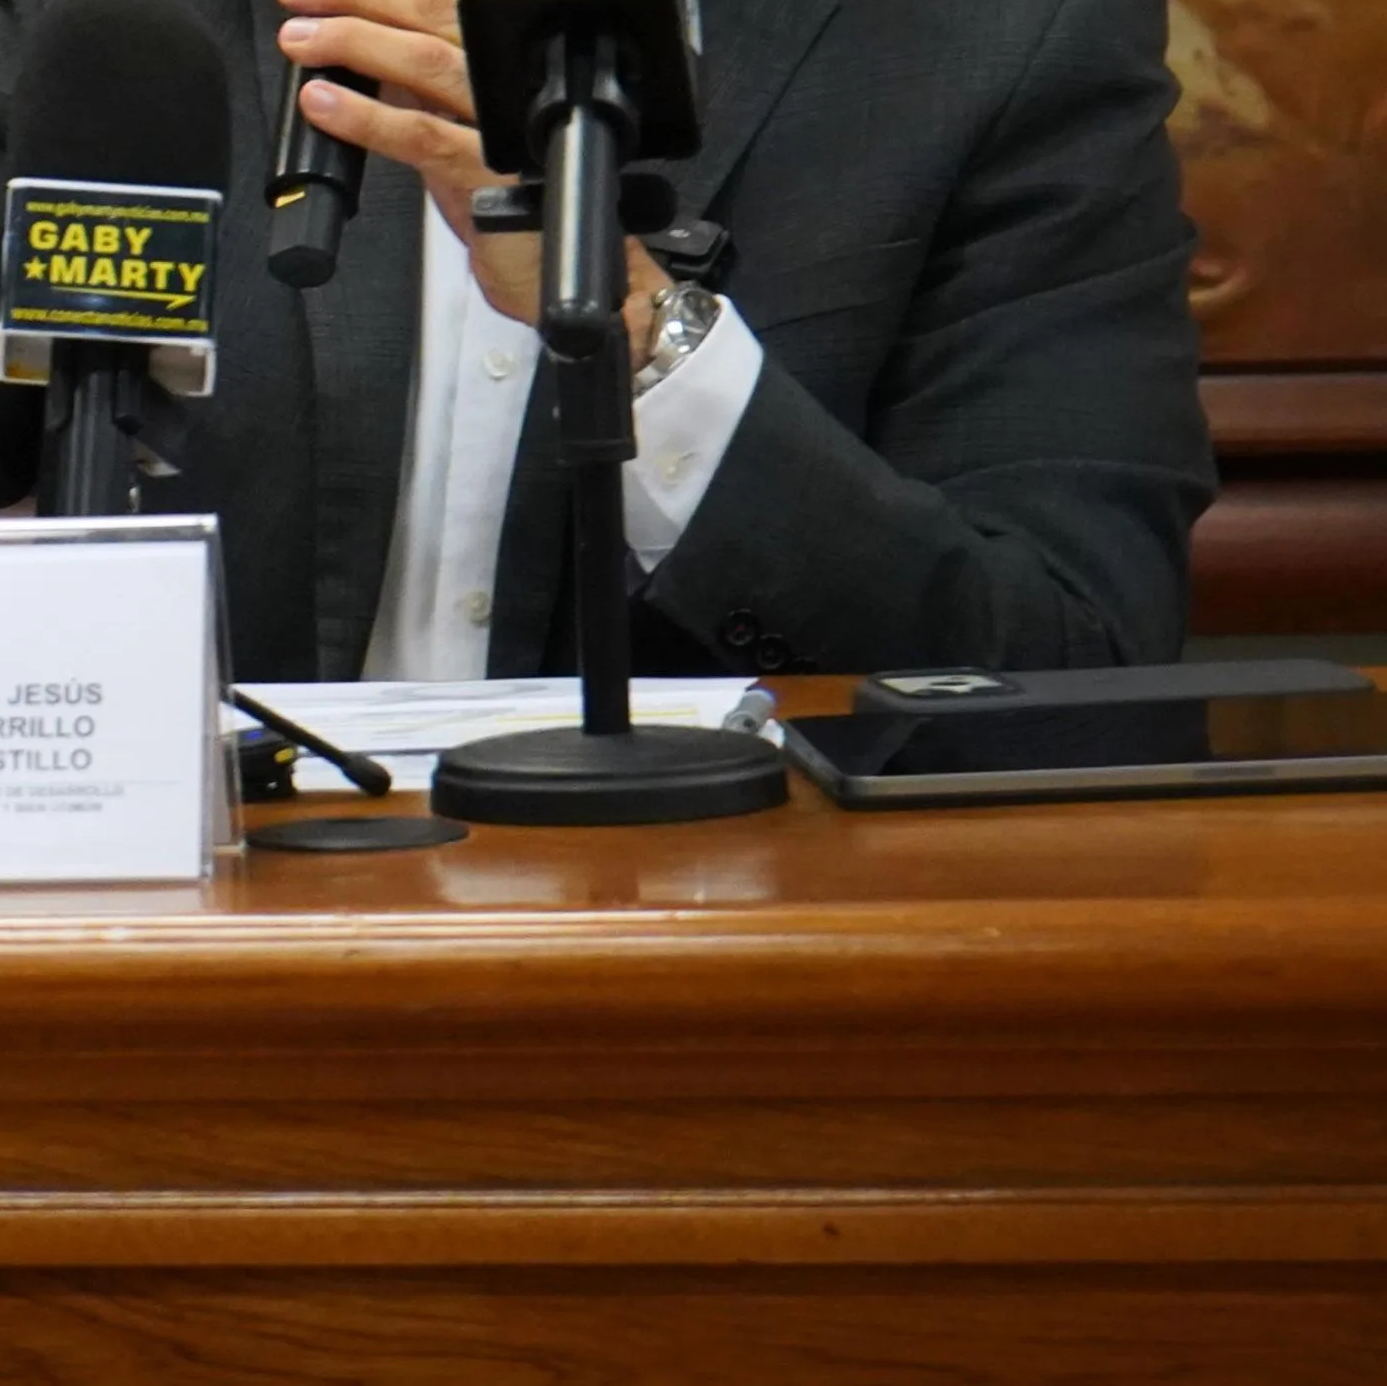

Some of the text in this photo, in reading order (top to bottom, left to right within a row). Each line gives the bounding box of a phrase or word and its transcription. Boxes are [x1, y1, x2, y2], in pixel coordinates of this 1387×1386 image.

[28, 221, 152, 255] GABY
[49, 255, 205, 292] MARTY
[7, 677, 103, 706] JESÚS
